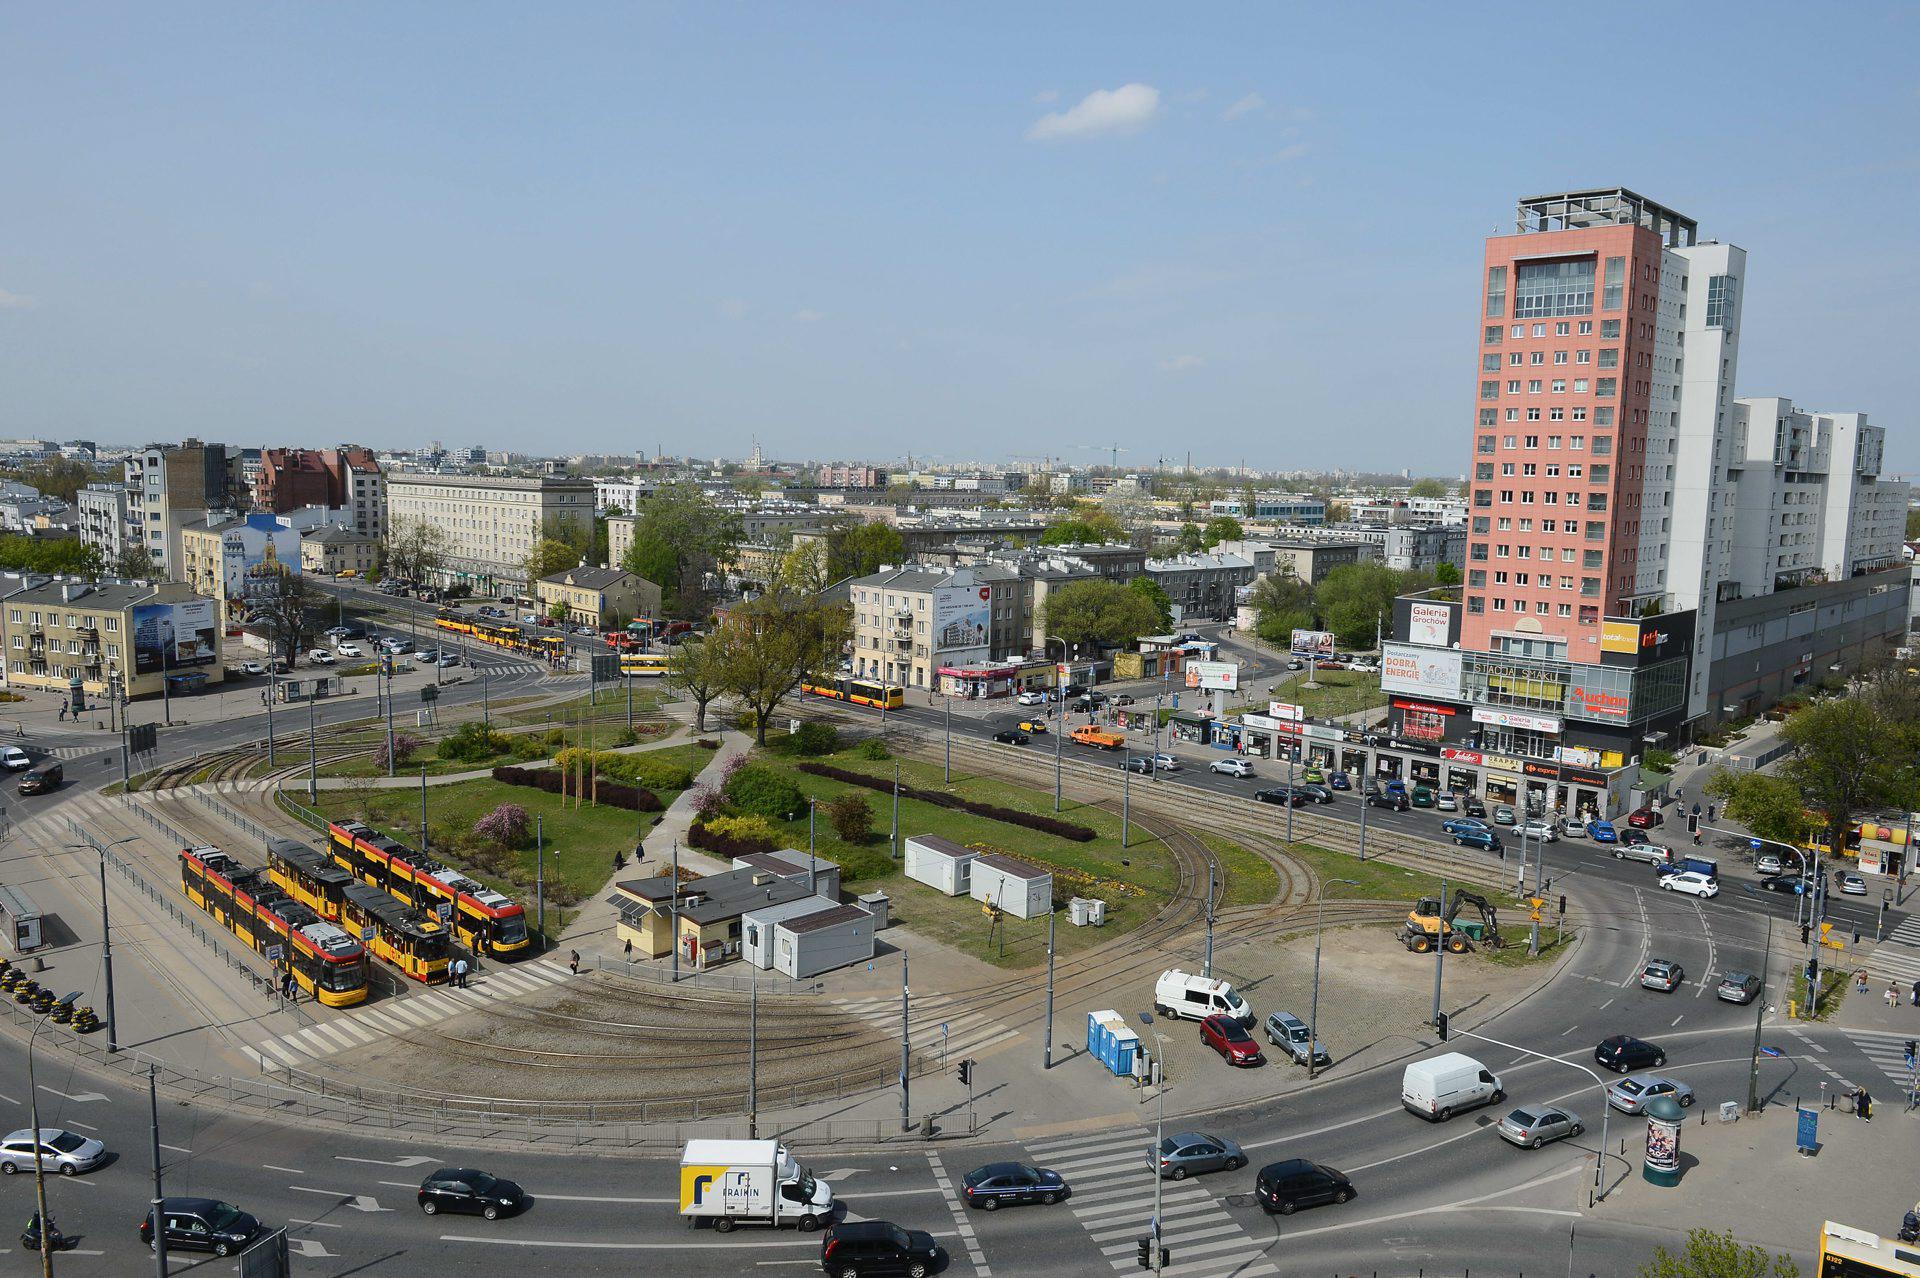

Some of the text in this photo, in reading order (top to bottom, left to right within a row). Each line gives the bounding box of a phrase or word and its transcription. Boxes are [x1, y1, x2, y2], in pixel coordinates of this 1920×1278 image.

[1413, 606, 1448, 617] Galeria
[1412, 615, 1447, 625] Grochów
[1386, 657, 1417, 670] DOBRĄ
[1385, 667, 1420, 680] ENERGIĘ
[1474, 663, 1558, 682] STACJA SMAKU
[1571, 687, 1628, 707] Auchan
[1508, 715, 1531, 724] Galeria
[1537, 767, 1560, 775] expres
[723, 1188, 759, 1197] FRAIKIN
